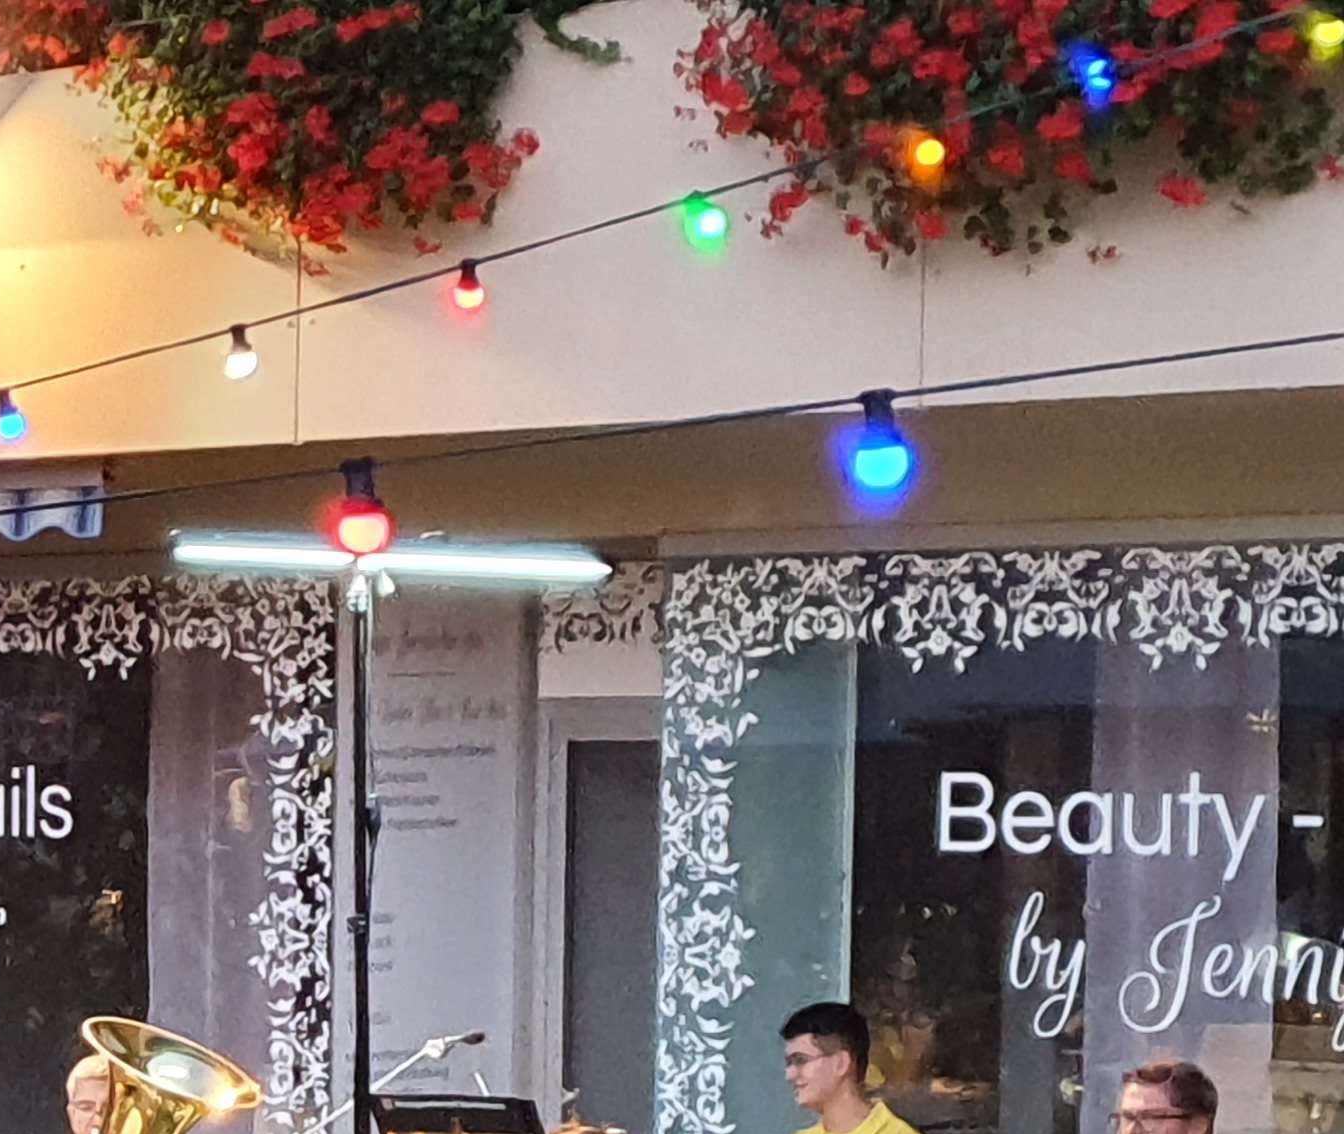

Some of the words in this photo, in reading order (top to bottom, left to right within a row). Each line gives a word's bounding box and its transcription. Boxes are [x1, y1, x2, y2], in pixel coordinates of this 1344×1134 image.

[938, 770, 1267, 882] Beauty
[1009, 891, 1087, 1038] by
[1118, 894, 1344, 1052] Jenni
